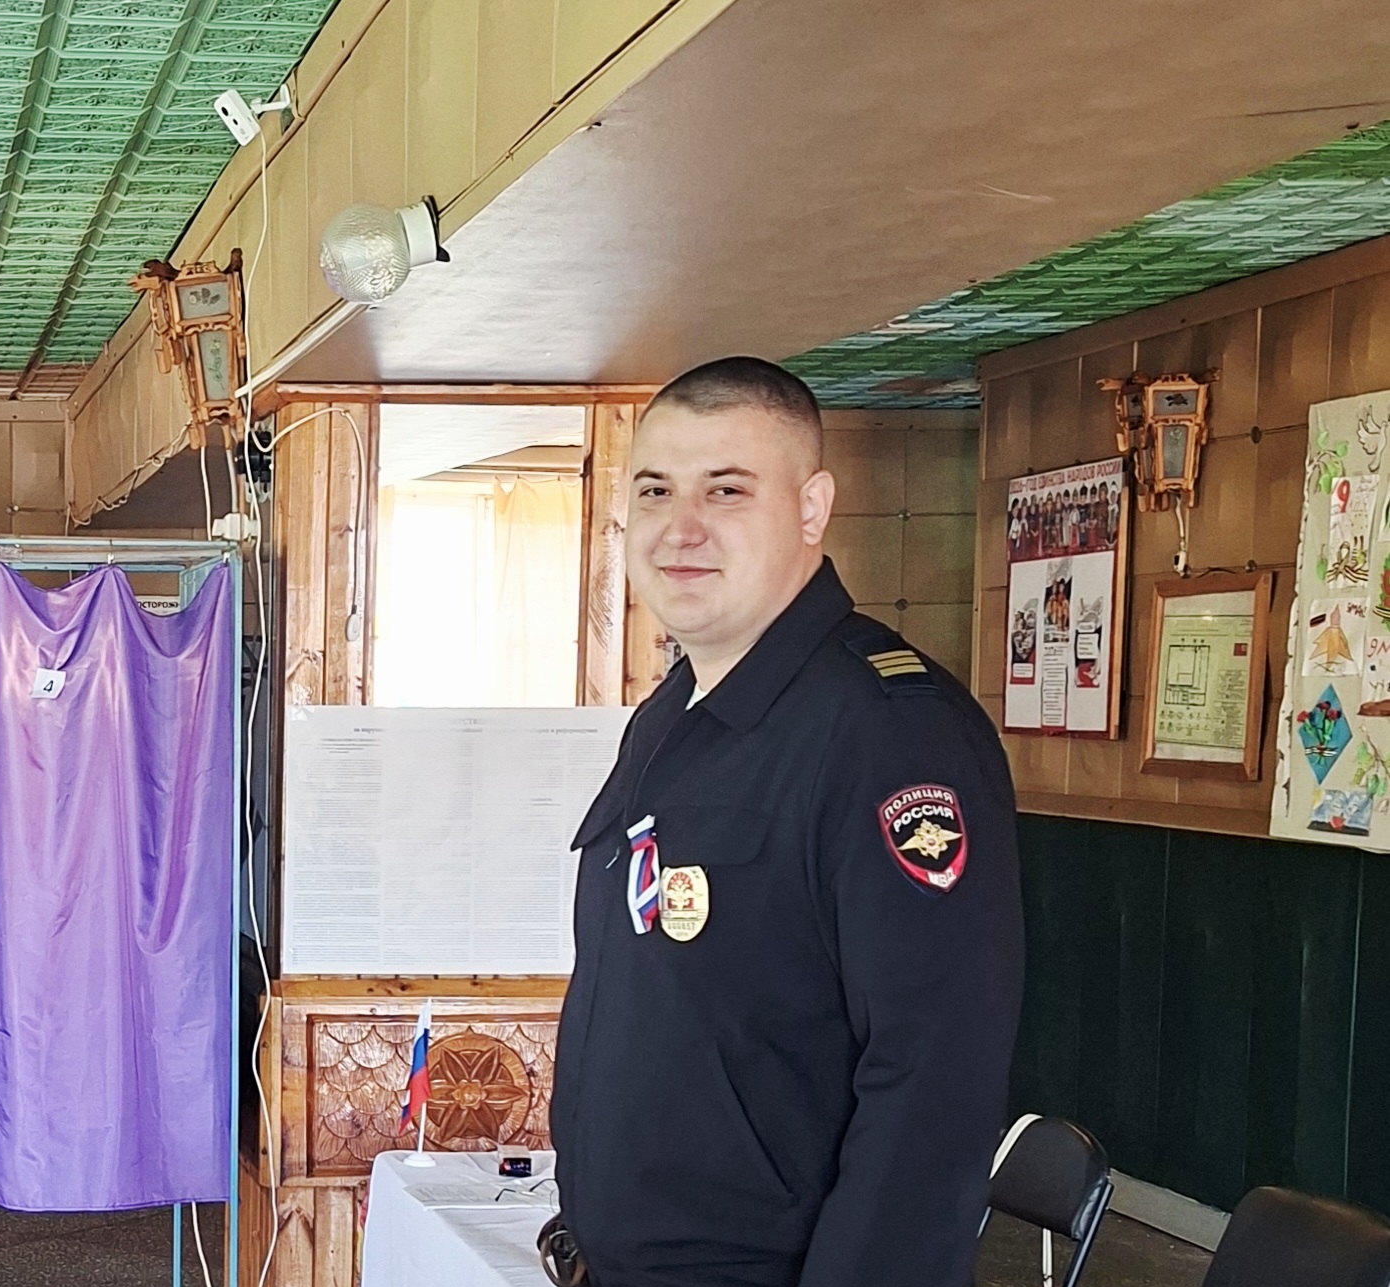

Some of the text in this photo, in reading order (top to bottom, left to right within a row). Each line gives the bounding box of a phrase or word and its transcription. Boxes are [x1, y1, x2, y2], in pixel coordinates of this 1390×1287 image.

[43, 680, 54, 692] 4
[884, 789, 954, 820] ПОЛИЦИЯ
[893, 804, 954, 833] РОССИЯ
